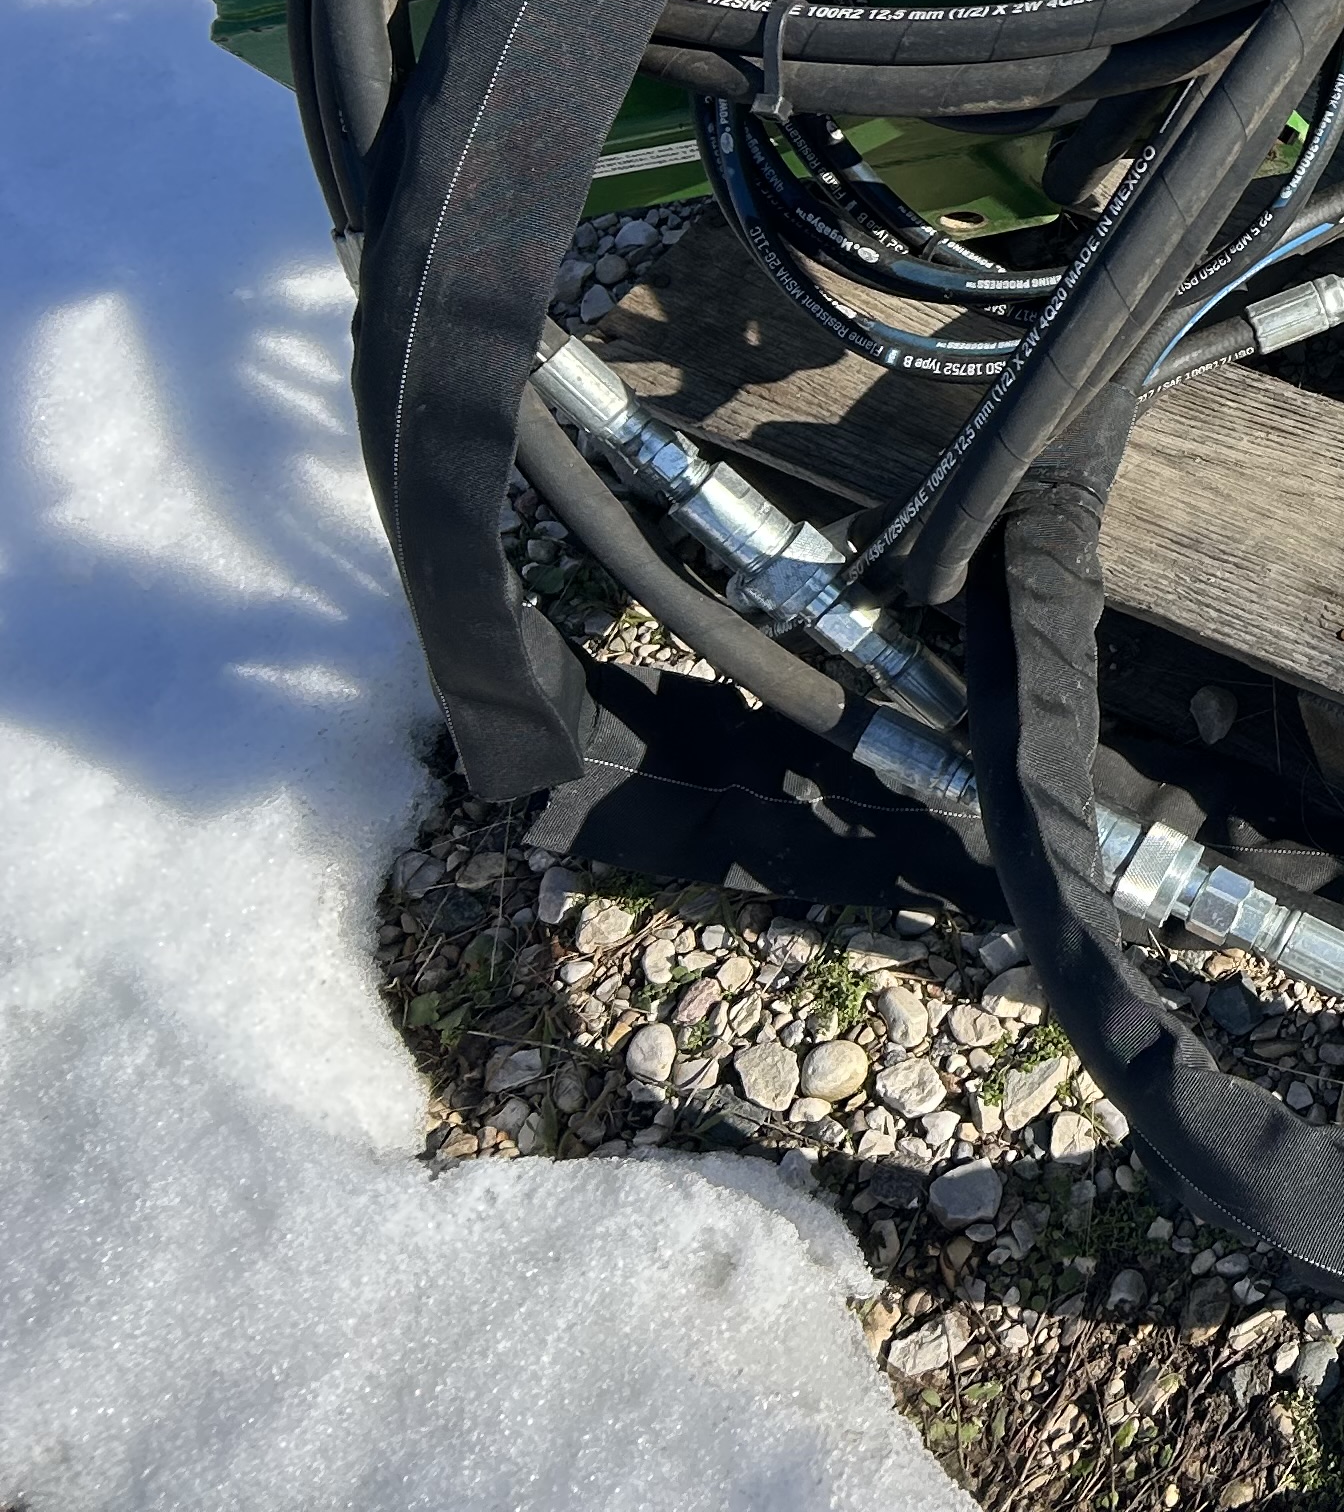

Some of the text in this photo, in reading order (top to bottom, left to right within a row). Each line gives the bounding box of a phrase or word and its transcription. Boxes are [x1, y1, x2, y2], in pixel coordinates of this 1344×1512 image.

[807, 6, 864, 20] 100R2
[868, 9, 905, 21] 12,5
[907, 9, 943, 20] mm
[948, 6, 990, 20] (1/2)
[991, 4, 1009, 16] X
[1012, 0, 1041, 15] 2W
[782, 118, 821, 169] Resistan
[776, 264, 801, 300] MSHA
[797, 291, 849, 339] Resistant
[848, 331, 884, 358] Flame
[846, 561, 867, 586] ISO
[863, 489, 930, 566] 1436-1/2SN/SAE
[925, 452, 957, 498] 100R2
[954, 422, 977, 460] 12,5
[974, 400, 997, 428] mm
[992, 367, 1018, 406] (1/2)
[1014, 355, 1025, 372] X
[1022, 328, 1042, 360] 2W
[1039, 285, 1070, 331] 4Q20
[1064, 237, 1101, 289] MADE
[1095, 211, 1113, 239] IN
[1109, 144, 1157, 215] MEXICO
[903, 355, 913, 367] B
[914, 357, 942, 375] Type
[944, 361, 983, 376] 18752
